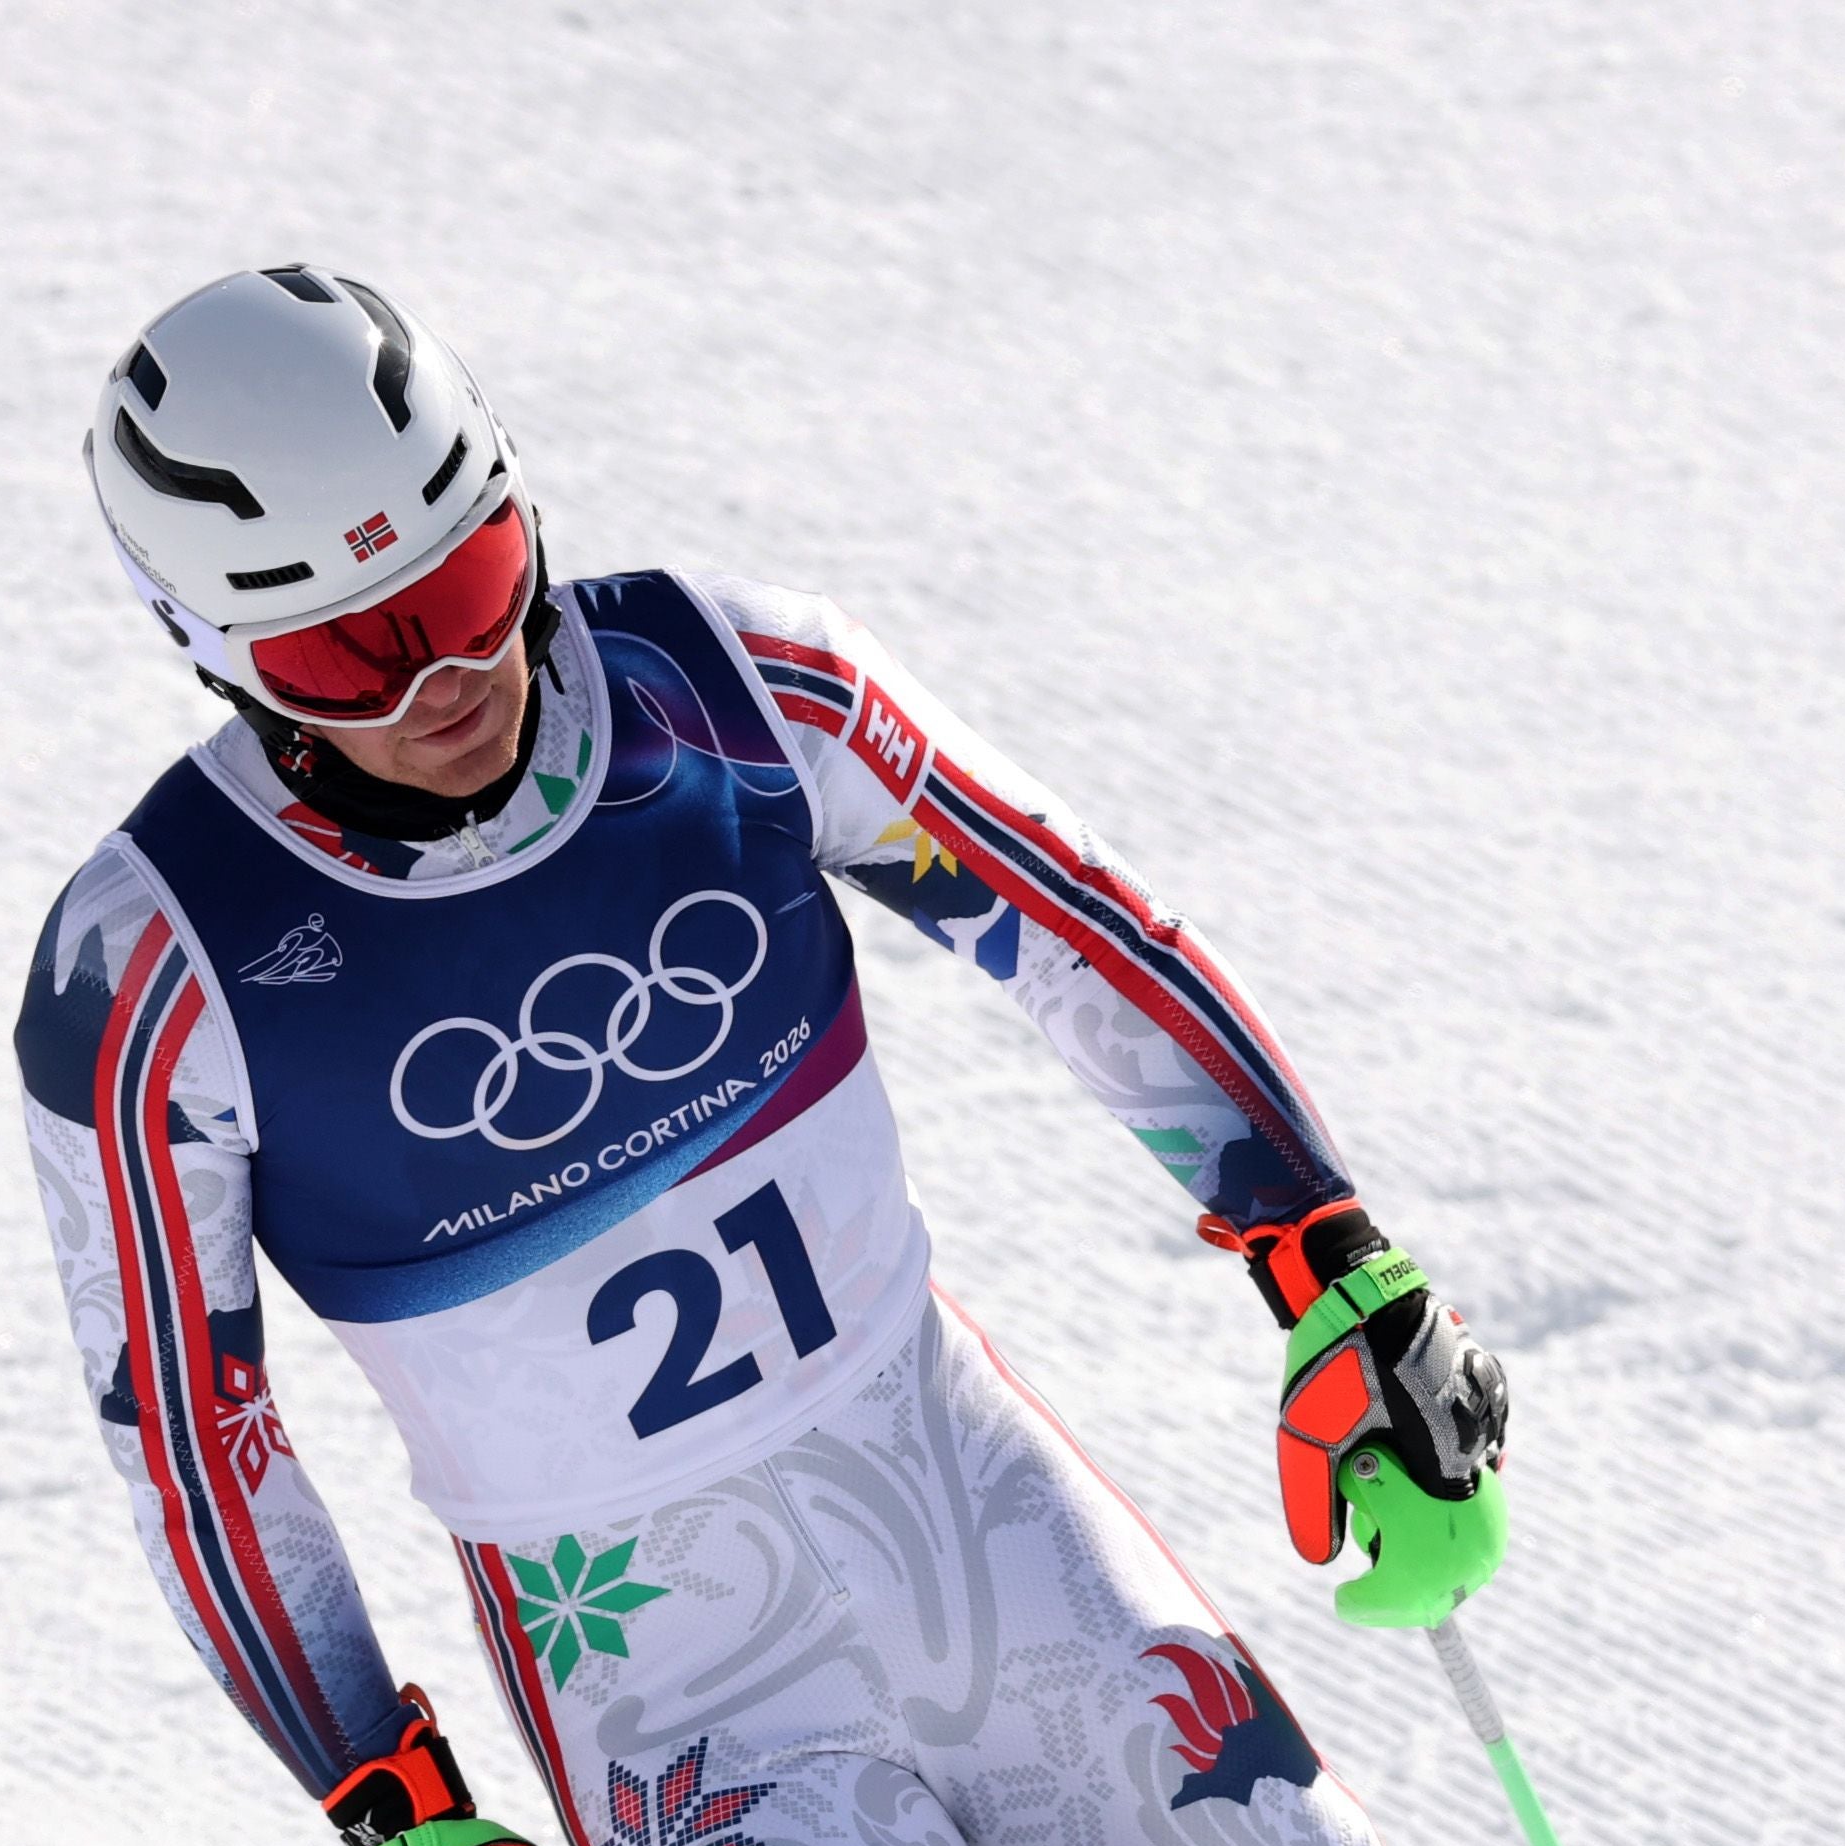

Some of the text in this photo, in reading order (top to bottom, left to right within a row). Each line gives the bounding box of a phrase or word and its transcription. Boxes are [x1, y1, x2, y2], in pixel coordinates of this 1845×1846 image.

[864, 698, 917, 780] HH
[423, 1016, 811, 1242] MILANO CORTINA 2026
[585, 1178, 838, 1440] 21
